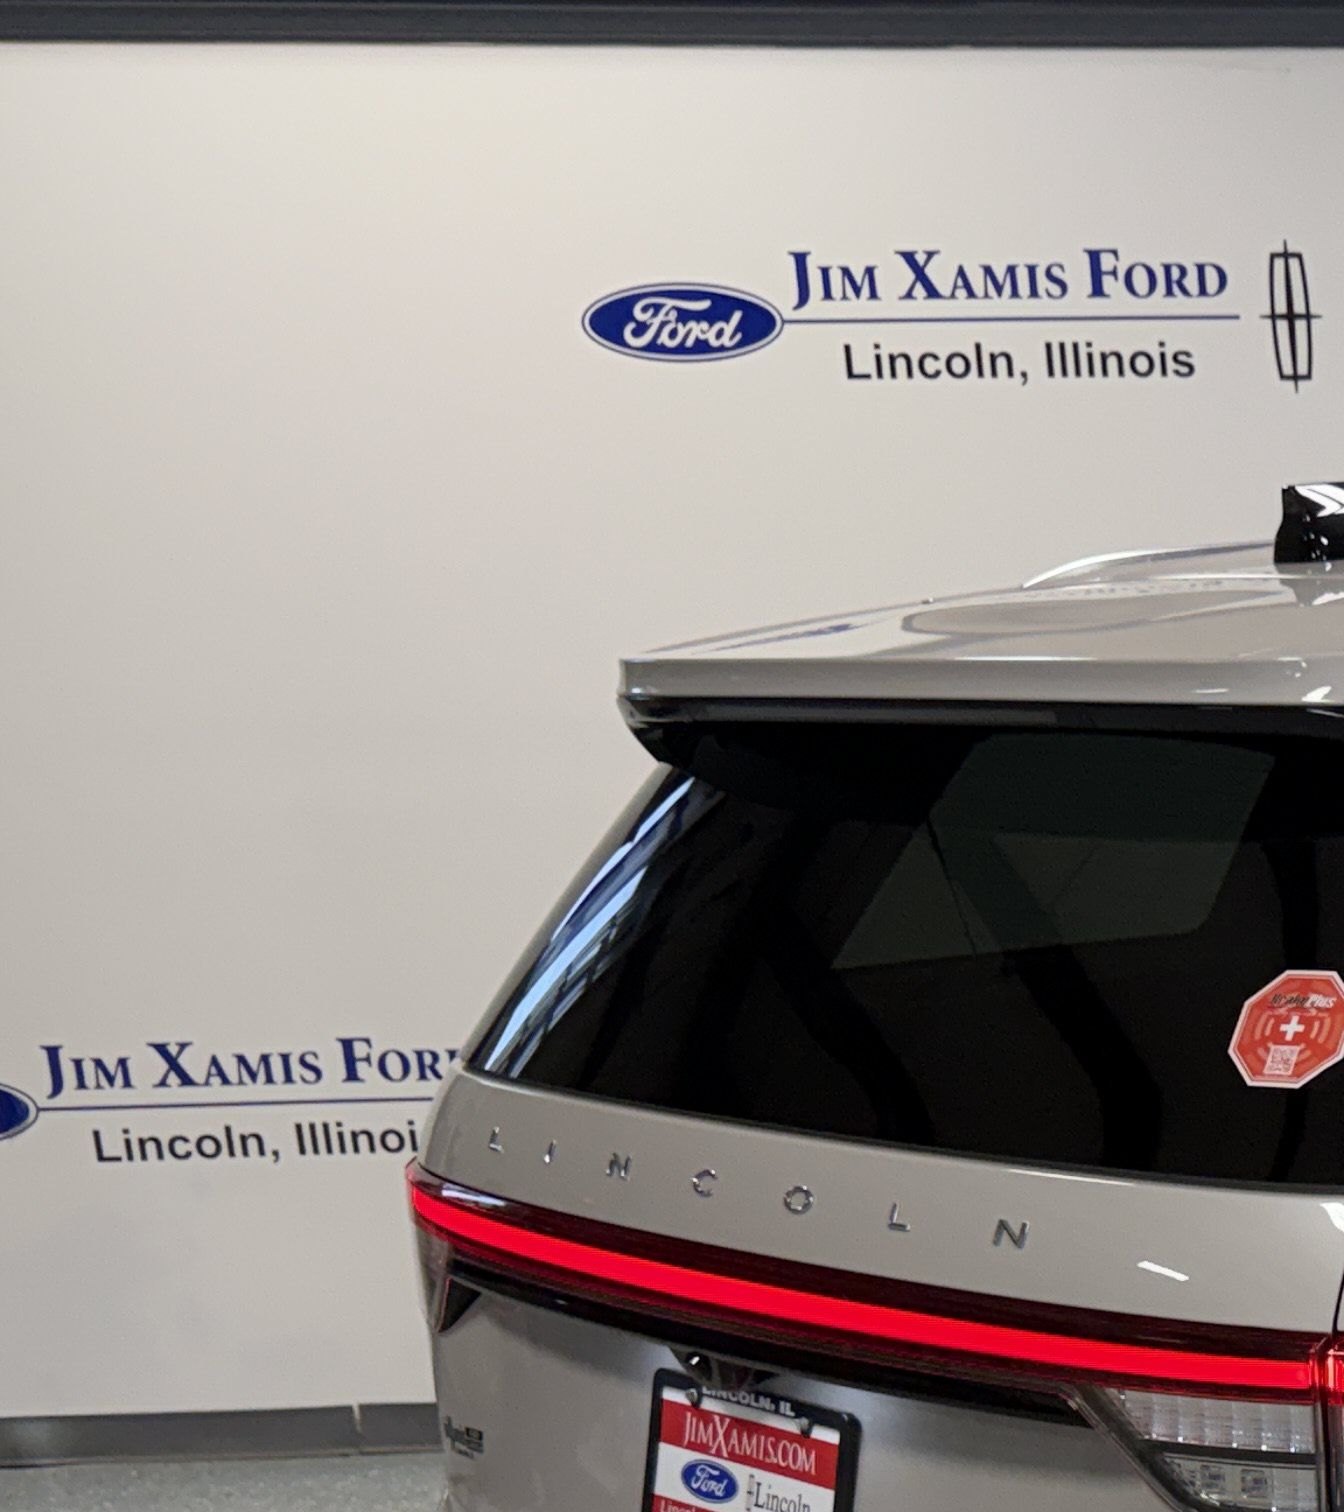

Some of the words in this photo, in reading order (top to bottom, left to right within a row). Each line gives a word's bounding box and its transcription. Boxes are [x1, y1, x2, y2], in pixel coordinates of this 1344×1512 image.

[788, 250, 879, 310] JIM
[893, 249, 1068, 301] XAMIS
[1082, 247, 1228, 299] FORD
[844, 340, 1029, 386] Lincoln,
[1046, 338, 1196, 380] Illinois
[40, 1044, 135, 1099] JIM
[146, 1040, 324, 1089] XAMIS
[336, 1036, 459, 1084] FOR
[92, 1123, 281, 1165] Lincoln,
[294, 1119, 419, 1157] Illinoi
[488, 1126, 1031, 1250] LINCOLN
[779, 1400, 796, 1417] IL
